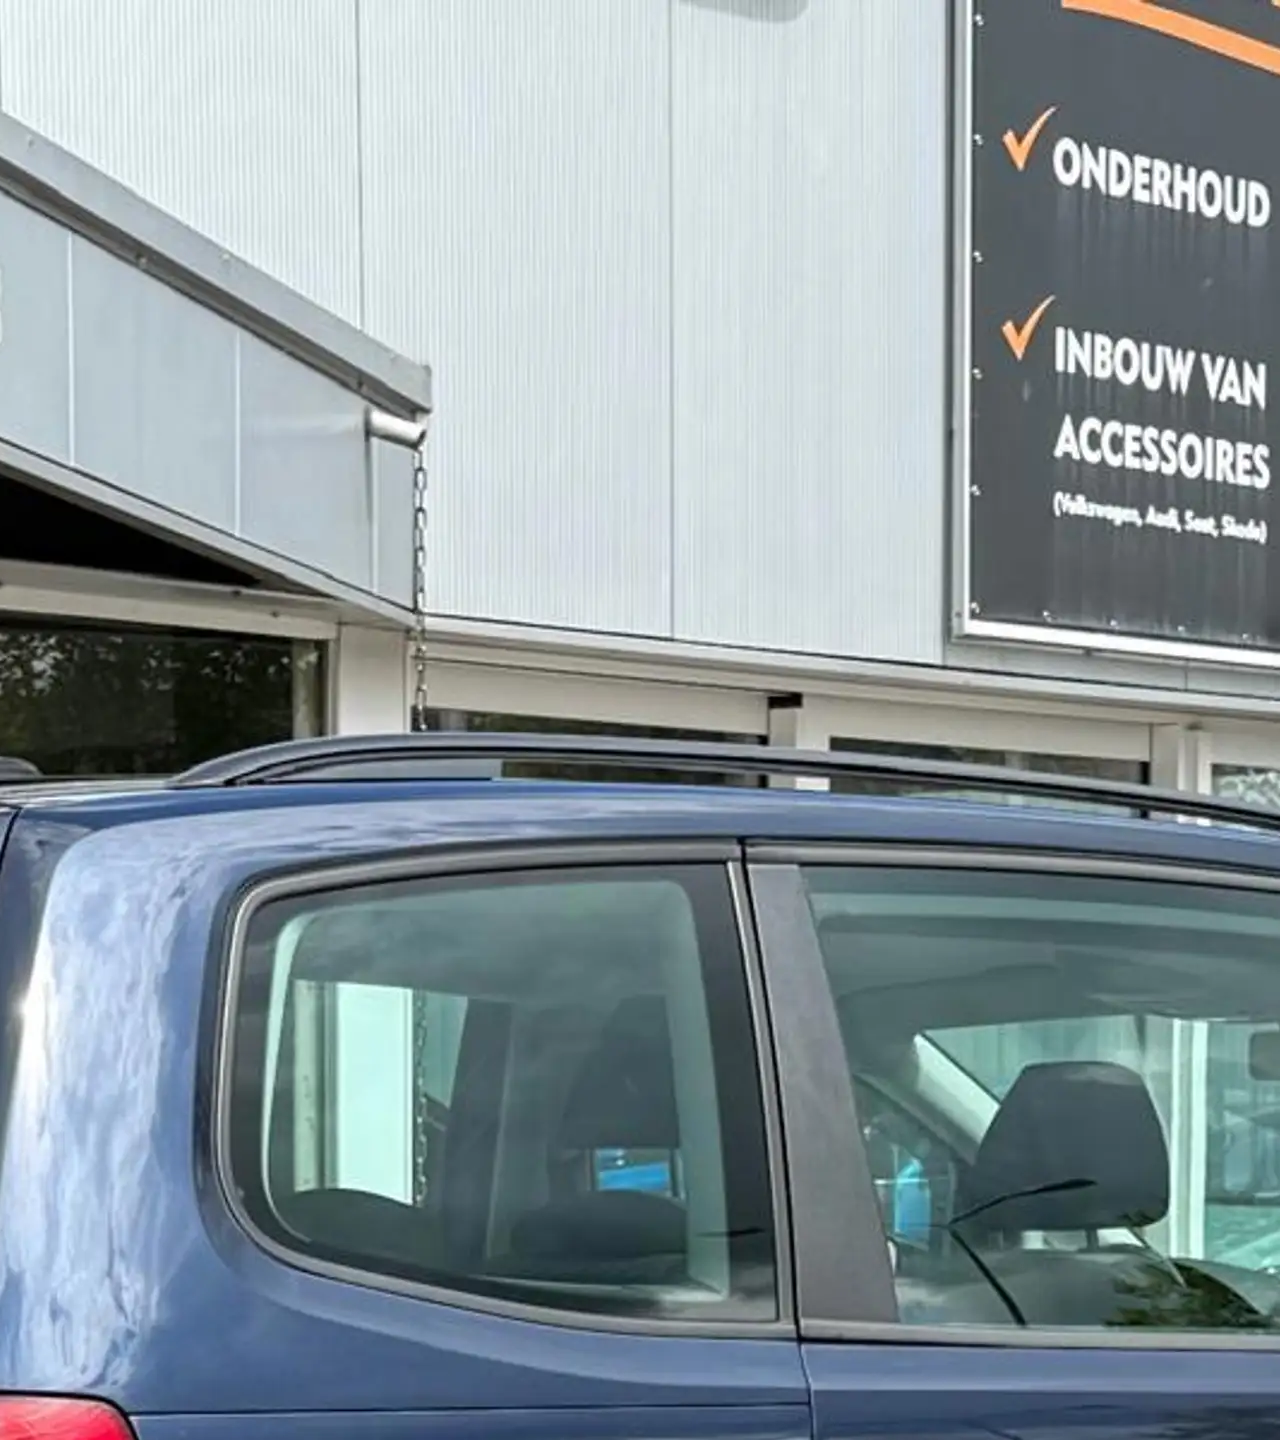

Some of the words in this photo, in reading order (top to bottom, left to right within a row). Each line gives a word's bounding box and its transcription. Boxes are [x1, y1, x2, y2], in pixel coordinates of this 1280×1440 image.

[1053, 137, 1270, 227] ONDERHOUD
[1055, 327, 1196, 396] INBOUW
[1201, 353, 1266, 410] VAN
[1054, 414, 1270, 489] ACCESSOIRES
